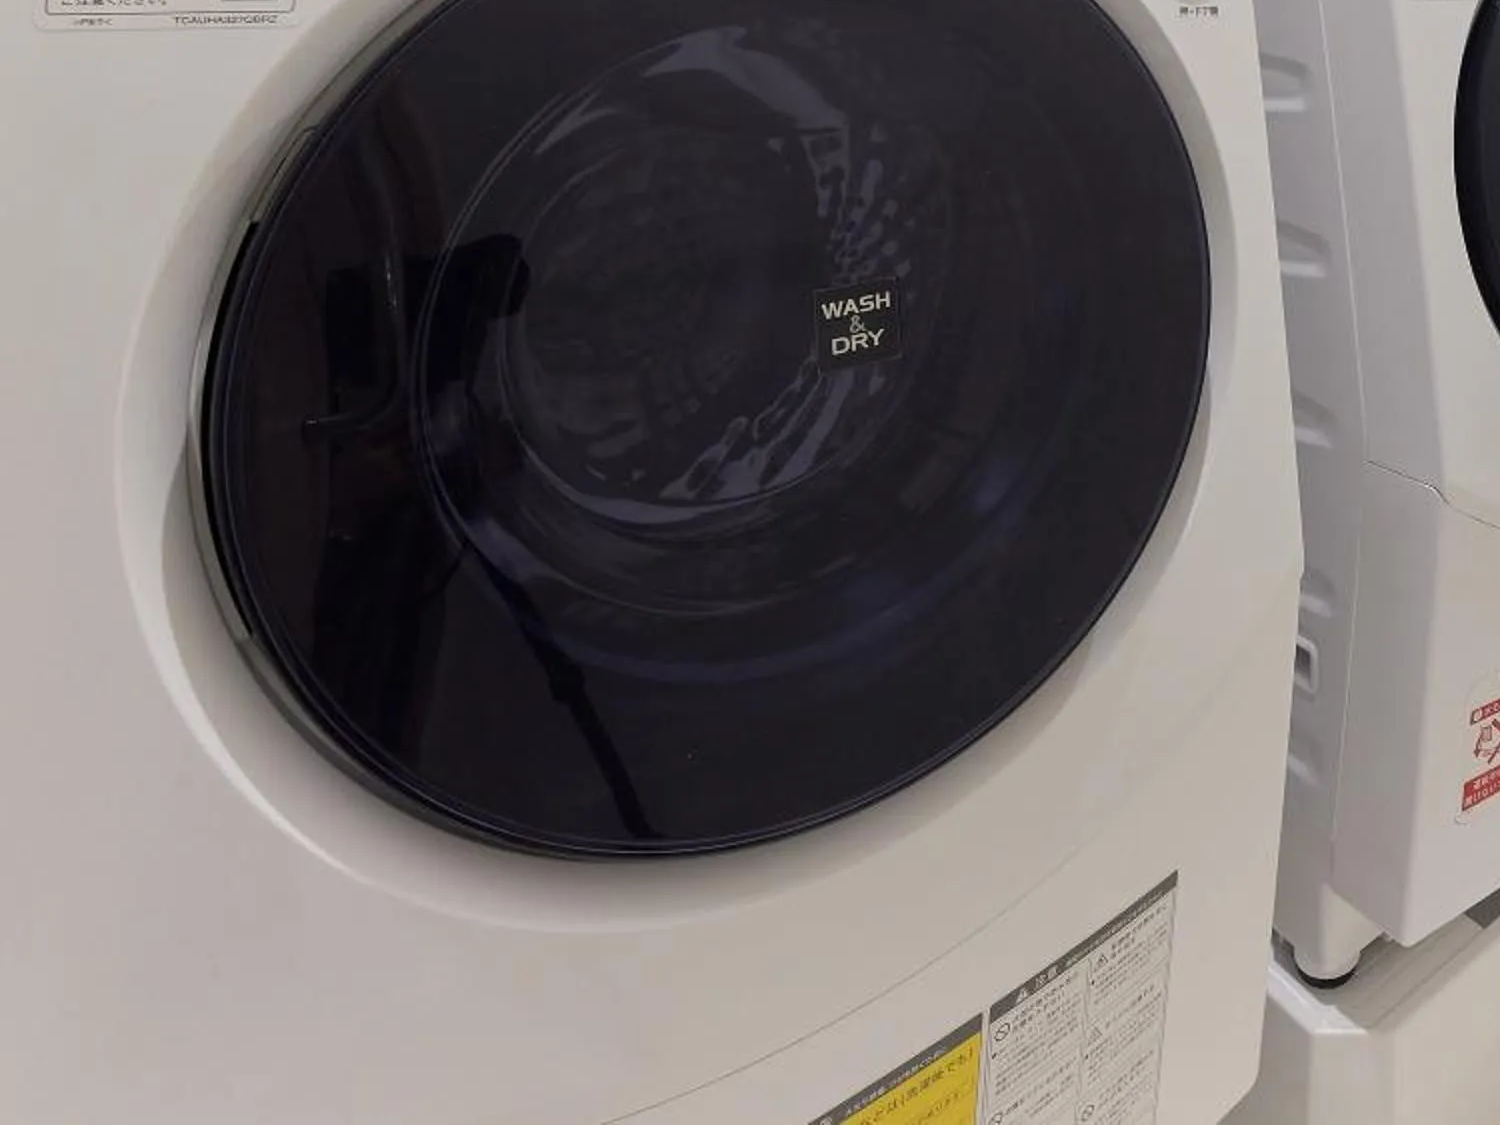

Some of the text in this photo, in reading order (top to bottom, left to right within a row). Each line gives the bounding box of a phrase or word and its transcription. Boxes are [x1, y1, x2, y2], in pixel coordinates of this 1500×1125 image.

[821, 290, 891, 320] WASH
[849, 315, 866, 334] &
[831, 328, 885, 356] DRY
